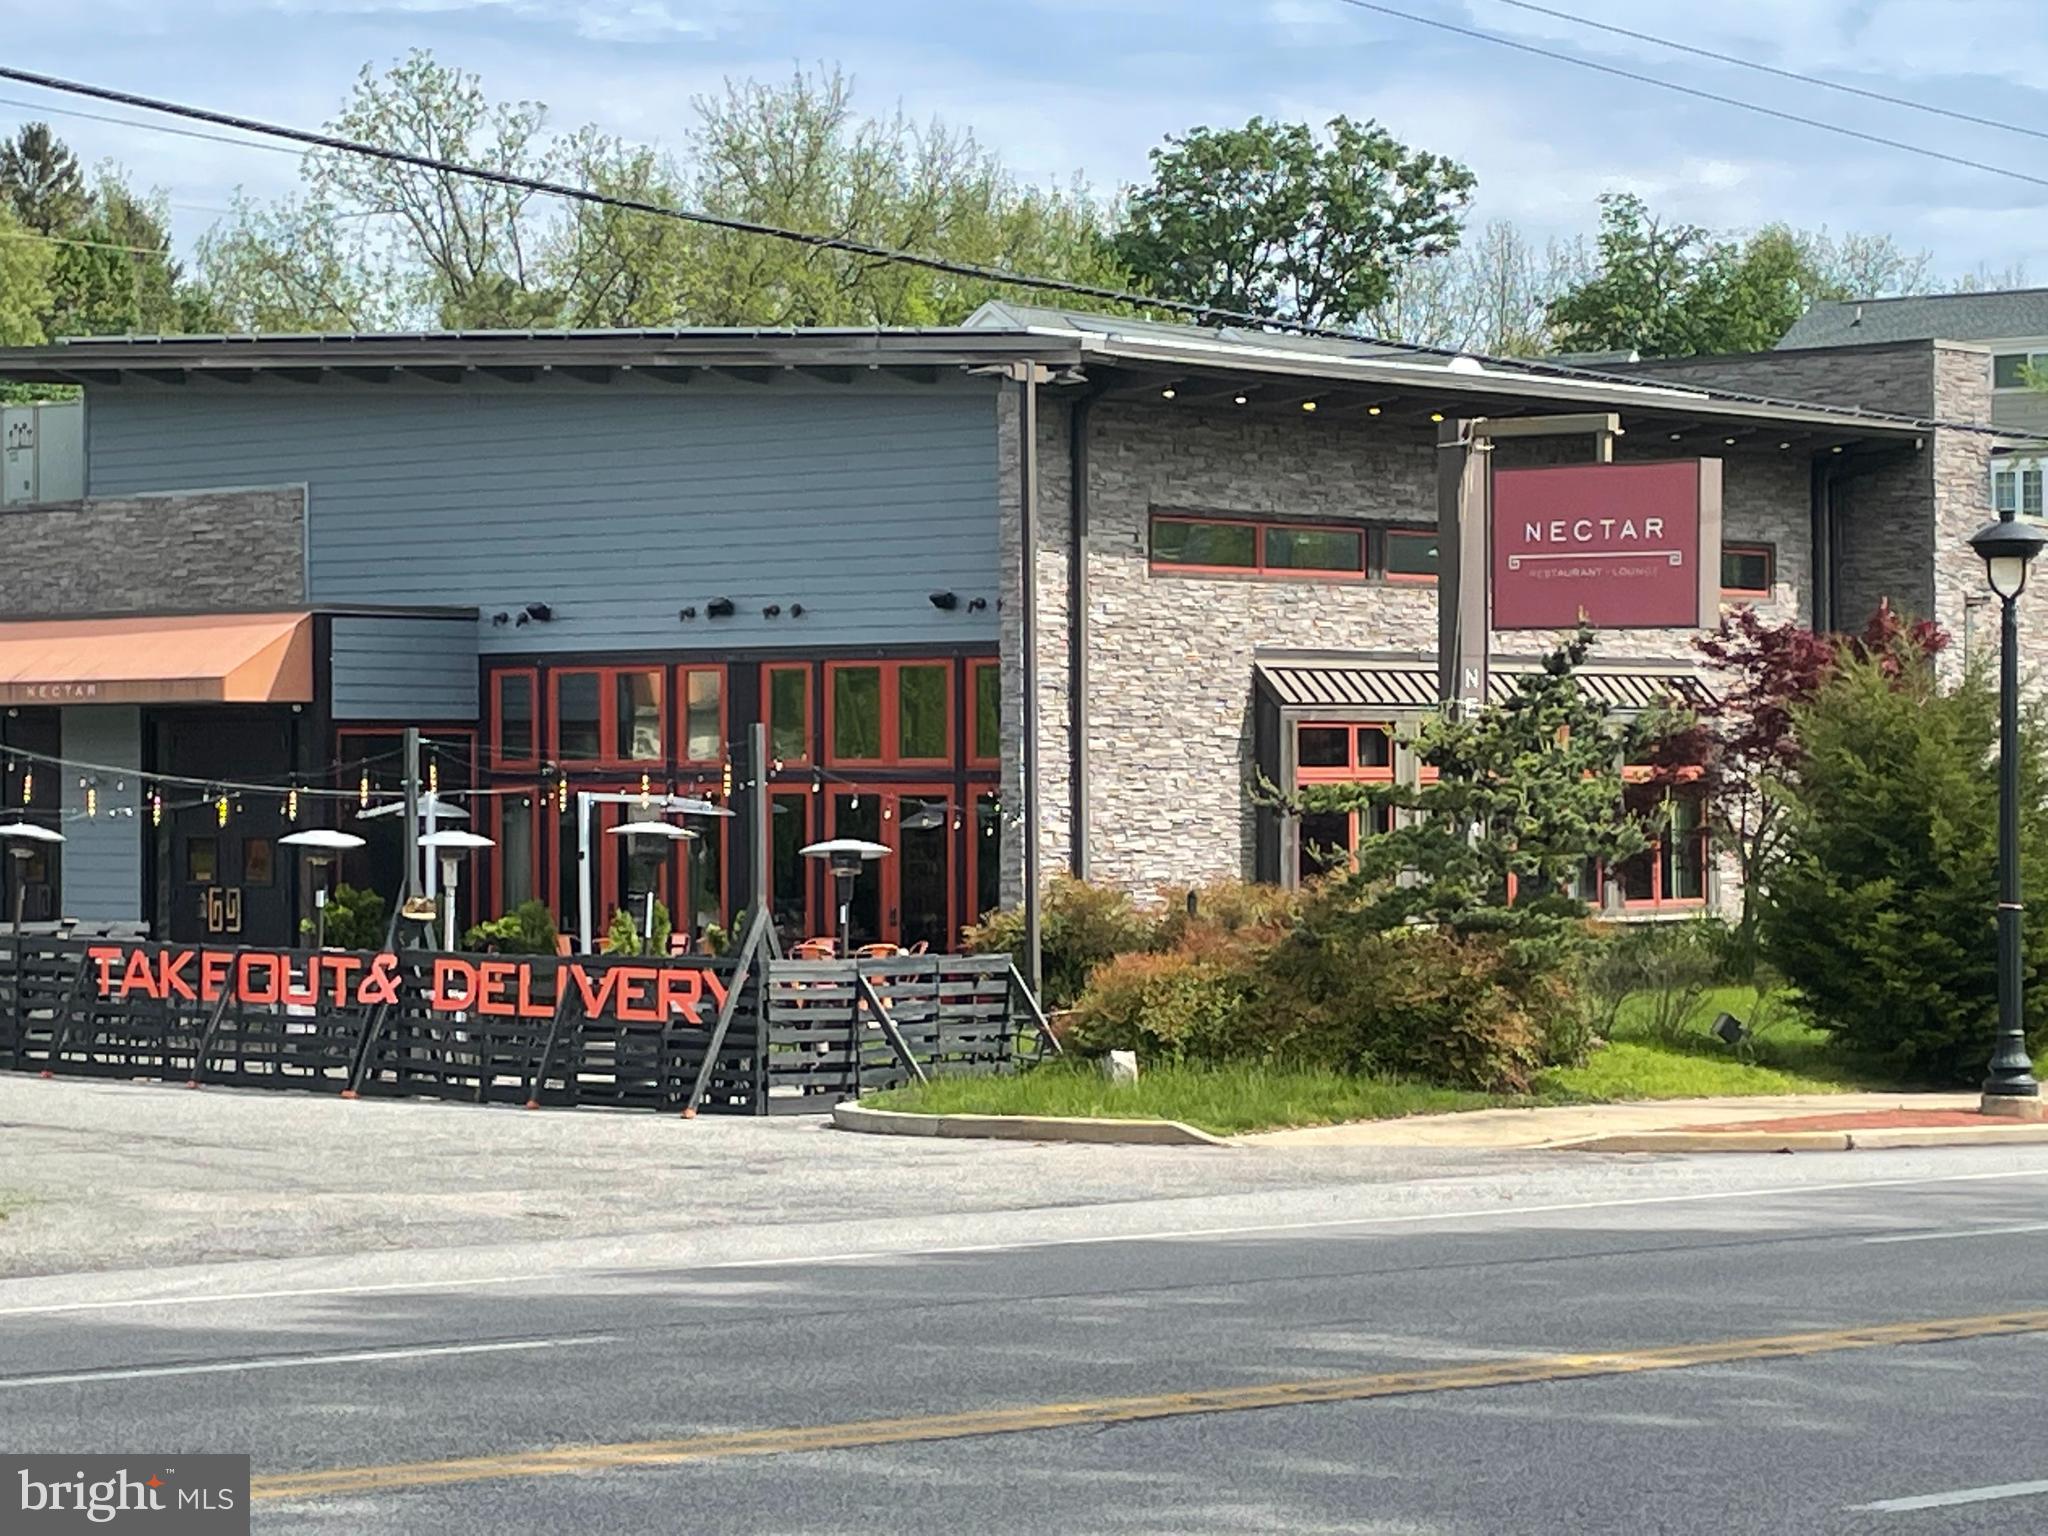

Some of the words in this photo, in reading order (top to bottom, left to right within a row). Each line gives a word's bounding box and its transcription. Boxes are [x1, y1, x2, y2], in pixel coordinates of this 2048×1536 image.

[1524, 517, 1664, 543] NECTAR
[26, 683, 97, 698] NECTAR
[432, 958, 749, 1025] DELIVERY
